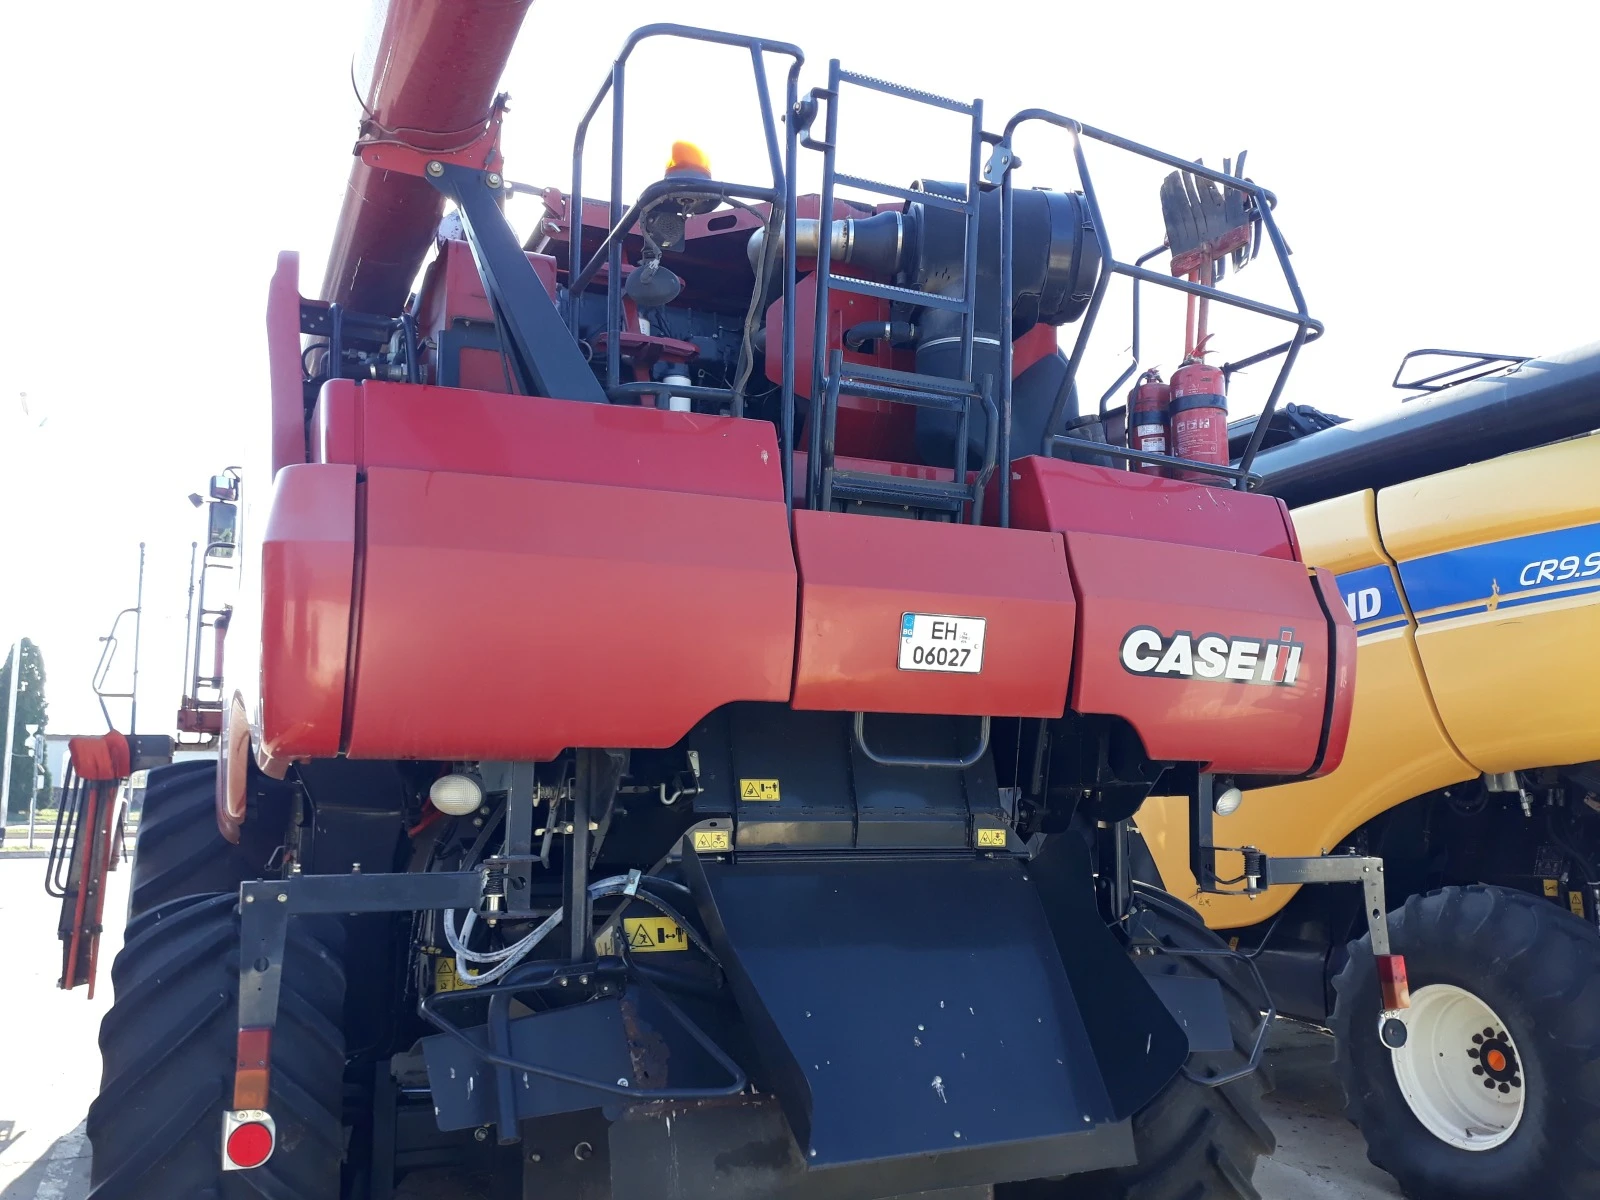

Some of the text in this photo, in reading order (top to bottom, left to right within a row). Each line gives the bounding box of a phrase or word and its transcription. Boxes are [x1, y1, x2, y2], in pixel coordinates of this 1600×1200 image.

[902, 628, 913, 636] BG
[931, 621, 958, 641] EH
[913, 646, 971, 667] 06027
[1122, 629, 1260, 679] CASE
